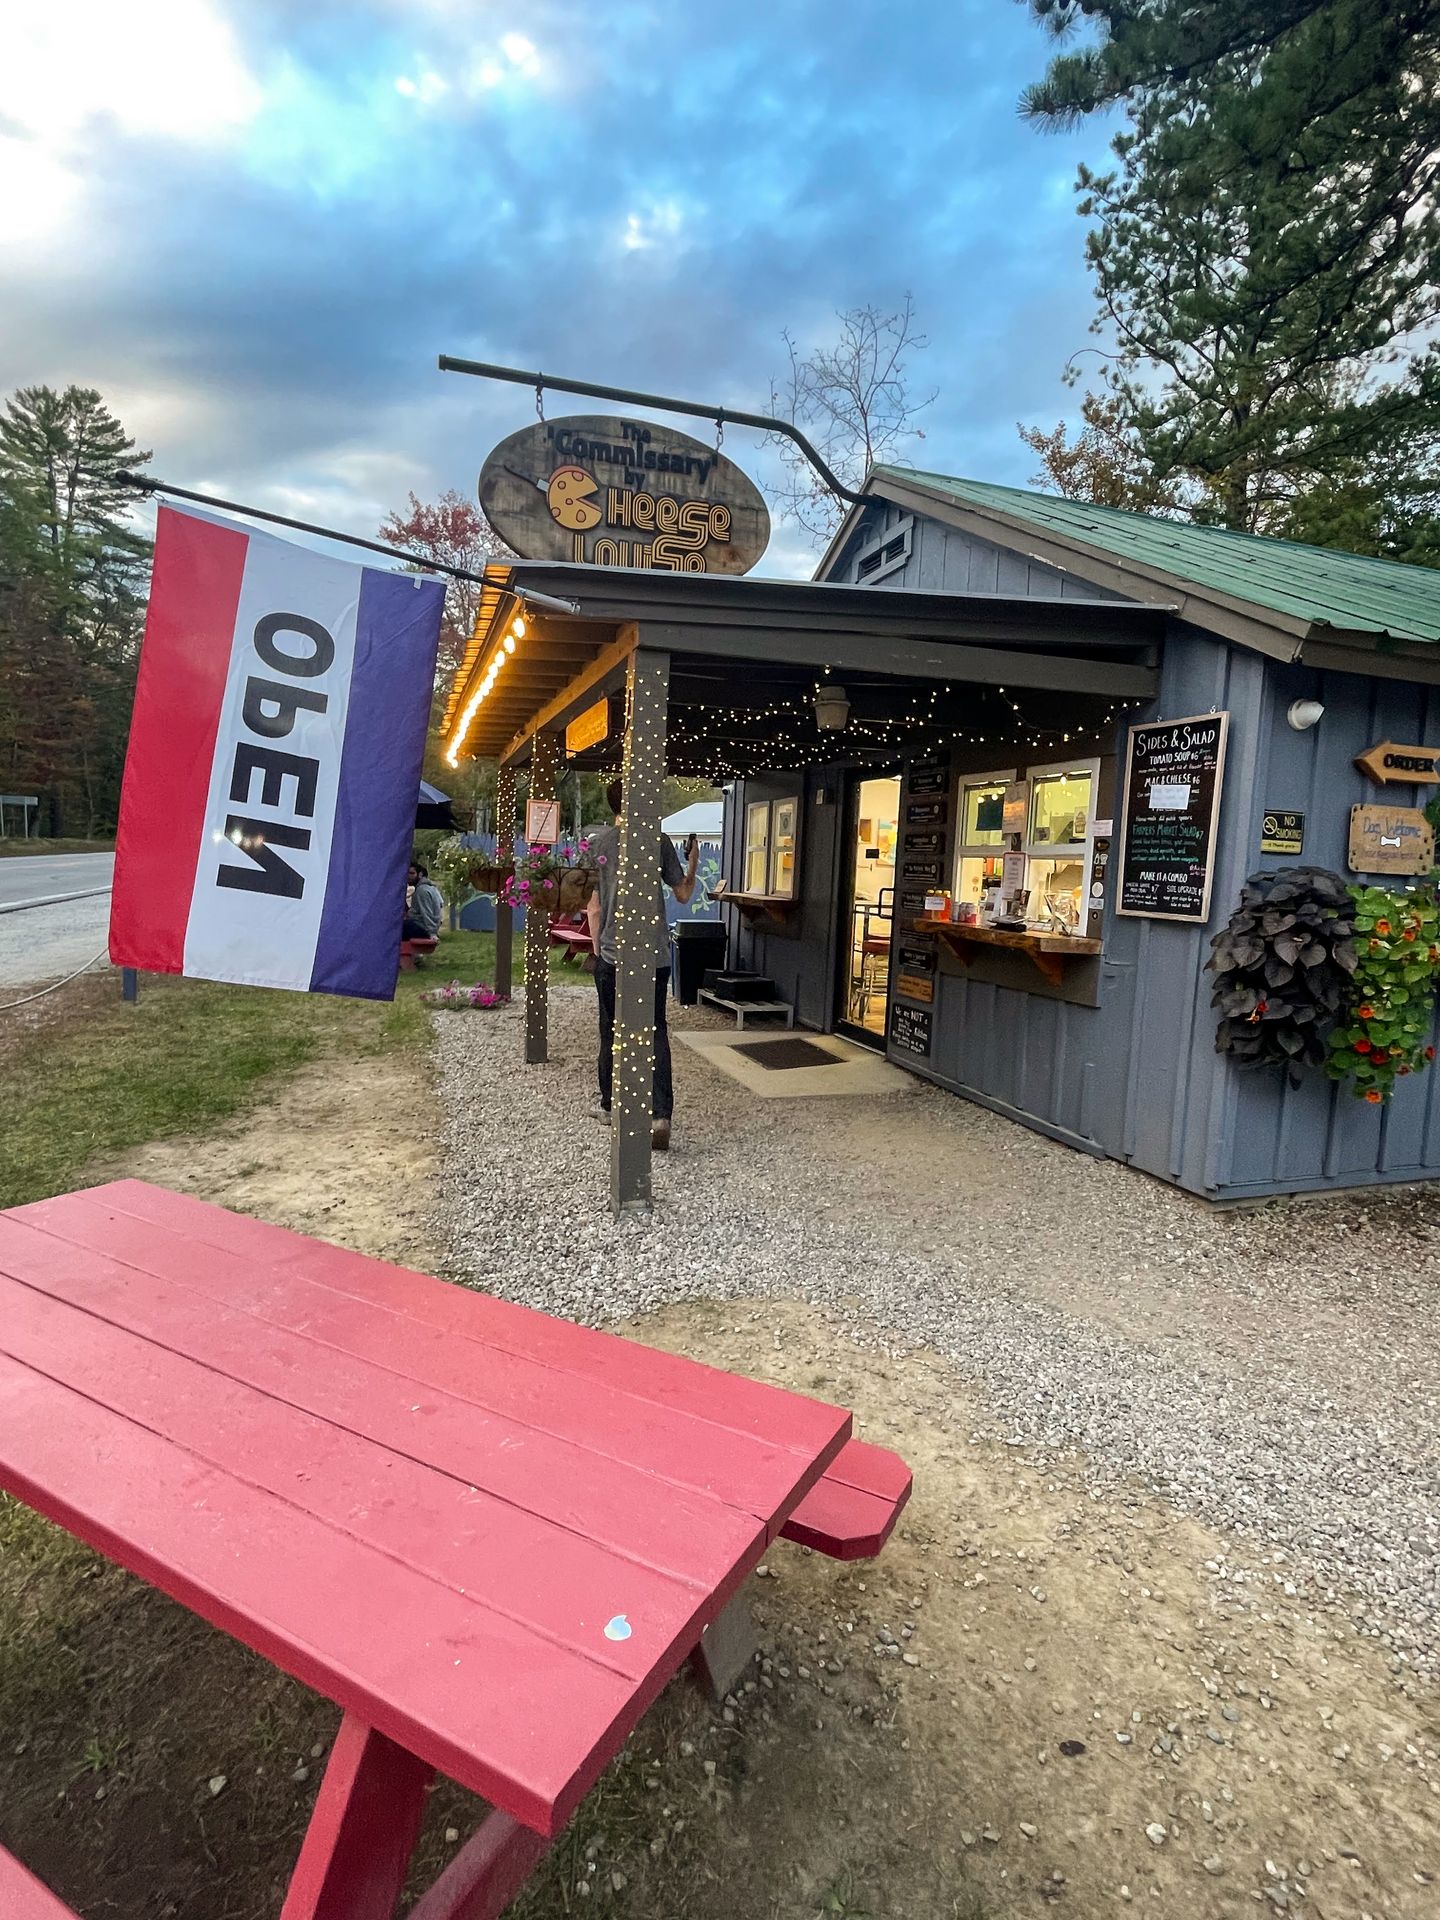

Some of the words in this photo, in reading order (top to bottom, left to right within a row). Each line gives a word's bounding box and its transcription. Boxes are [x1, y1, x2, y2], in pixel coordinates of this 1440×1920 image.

[620, 420, 651, 444] The
[624, 466, 645, 491] by
[1170, 728, 1179, 748] &
[1149, 753, 1173, 765] TOMATO
[1174, 751, 1191, 762] SOUP
[1383, 753, 1435, 773] ORDER
[1166, 773, 1191, 784] CHEESE
[1284, 815, 1296, 827] NO
[1275, 827, 1302, 839] SMOKING
[1139, 871, 1156, 881] MAKE
[1162, 873, 1167, 882] A
[1167, 872, 1188, 883] COMBO
[1177, 886, 1198, 896] UPGRADE
[910, 1009, 924, 1023] NOT
